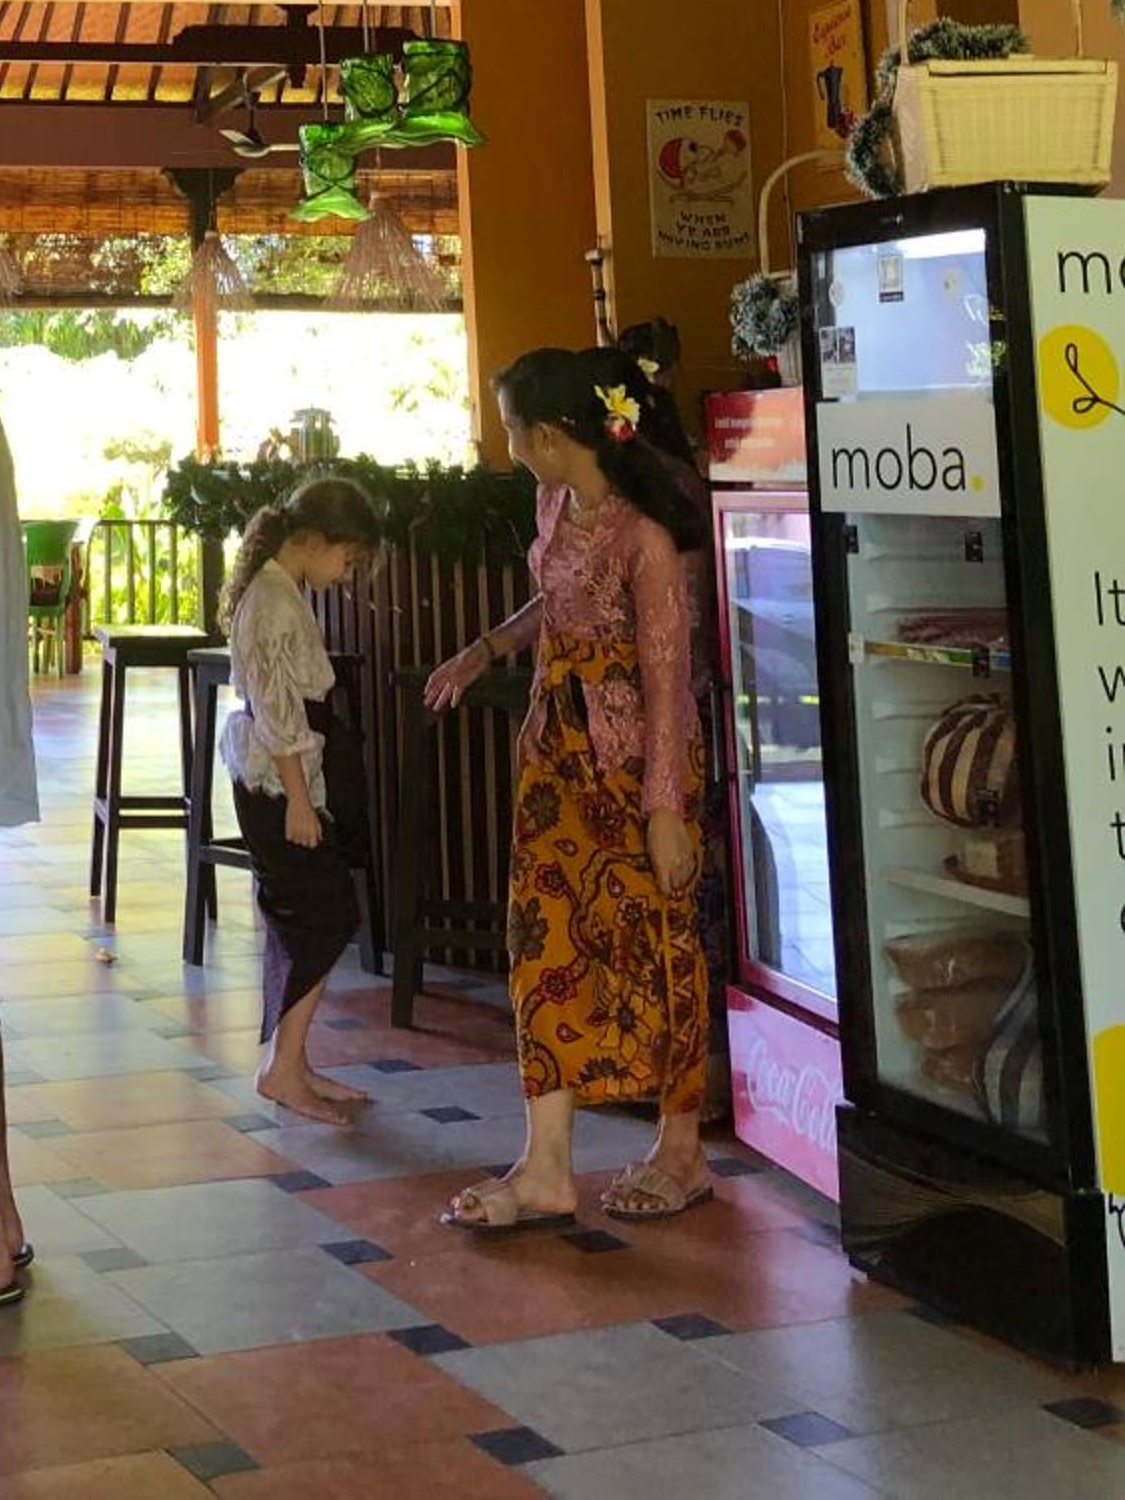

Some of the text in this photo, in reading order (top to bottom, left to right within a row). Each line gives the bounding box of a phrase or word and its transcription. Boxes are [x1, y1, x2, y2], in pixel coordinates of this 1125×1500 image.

[655, 105, 745, 128] TIME FLIES
[1057, 251, 1125, 294] m
